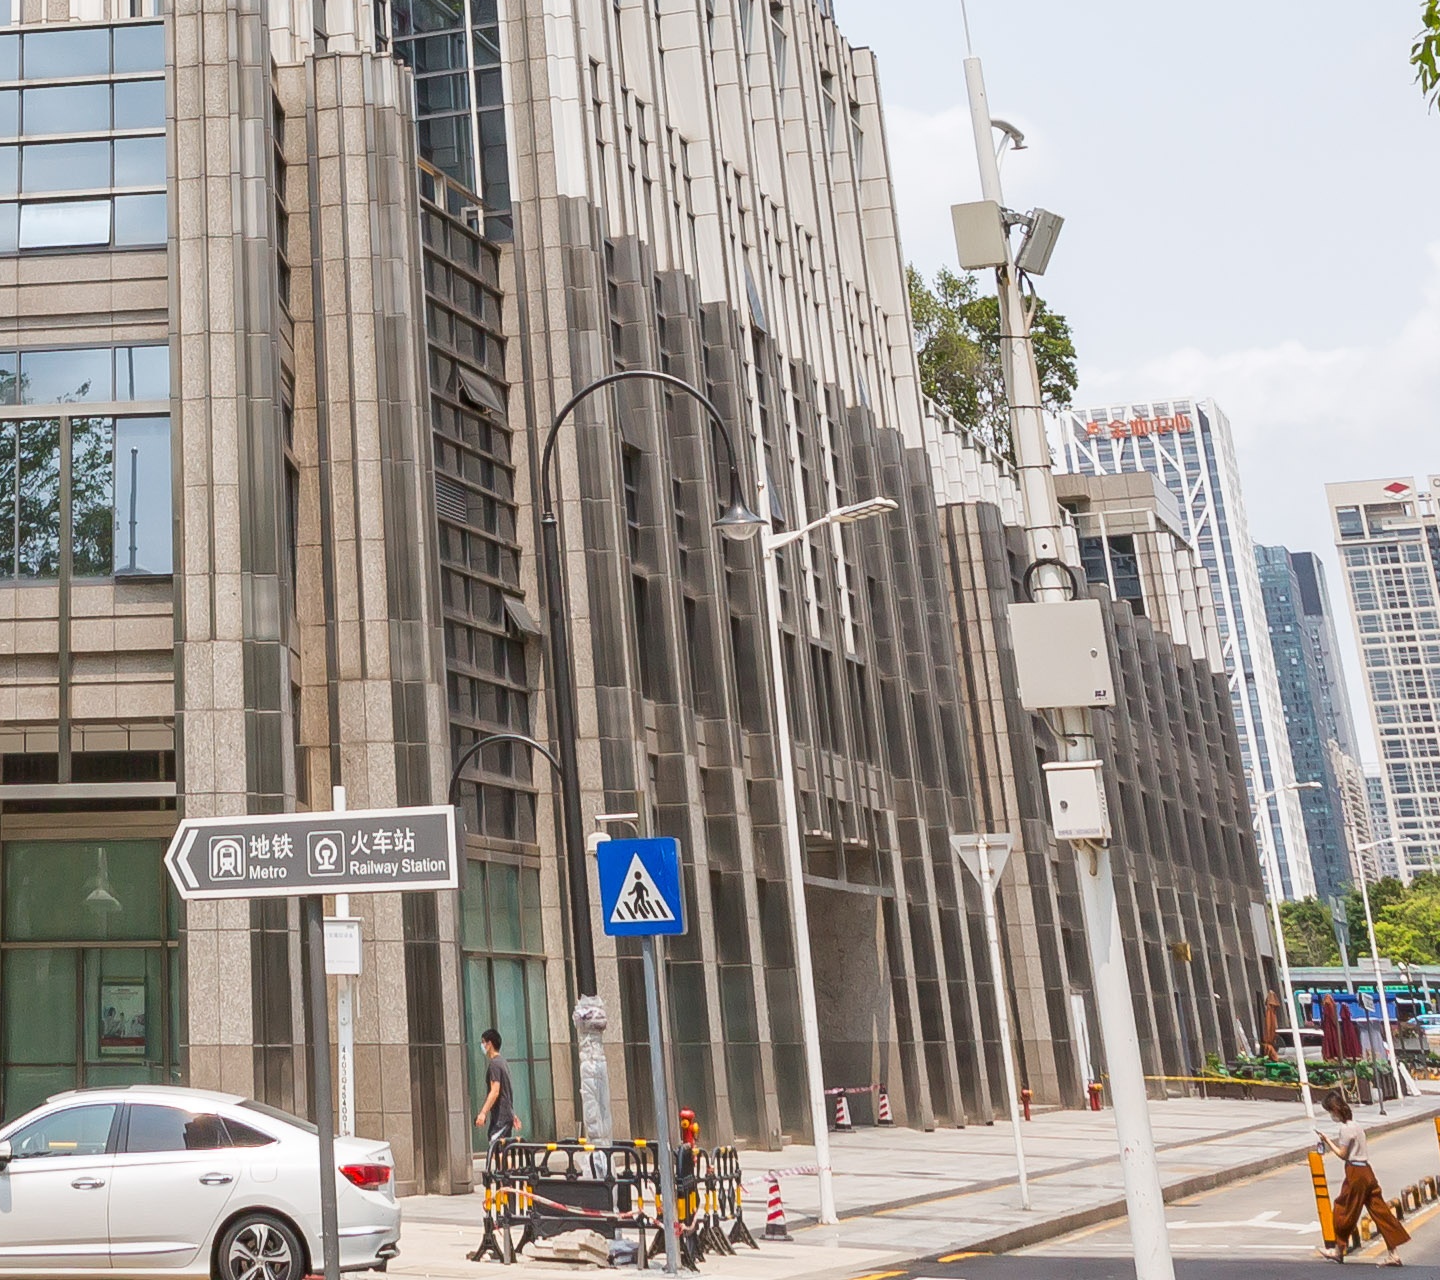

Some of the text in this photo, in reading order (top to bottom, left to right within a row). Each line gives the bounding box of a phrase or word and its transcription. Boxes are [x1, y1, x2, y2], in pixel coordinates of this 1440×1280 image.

[249, 827, 416, 861] 地铁 火车站
[249, 857, 446, 880] Metro Railway Station
